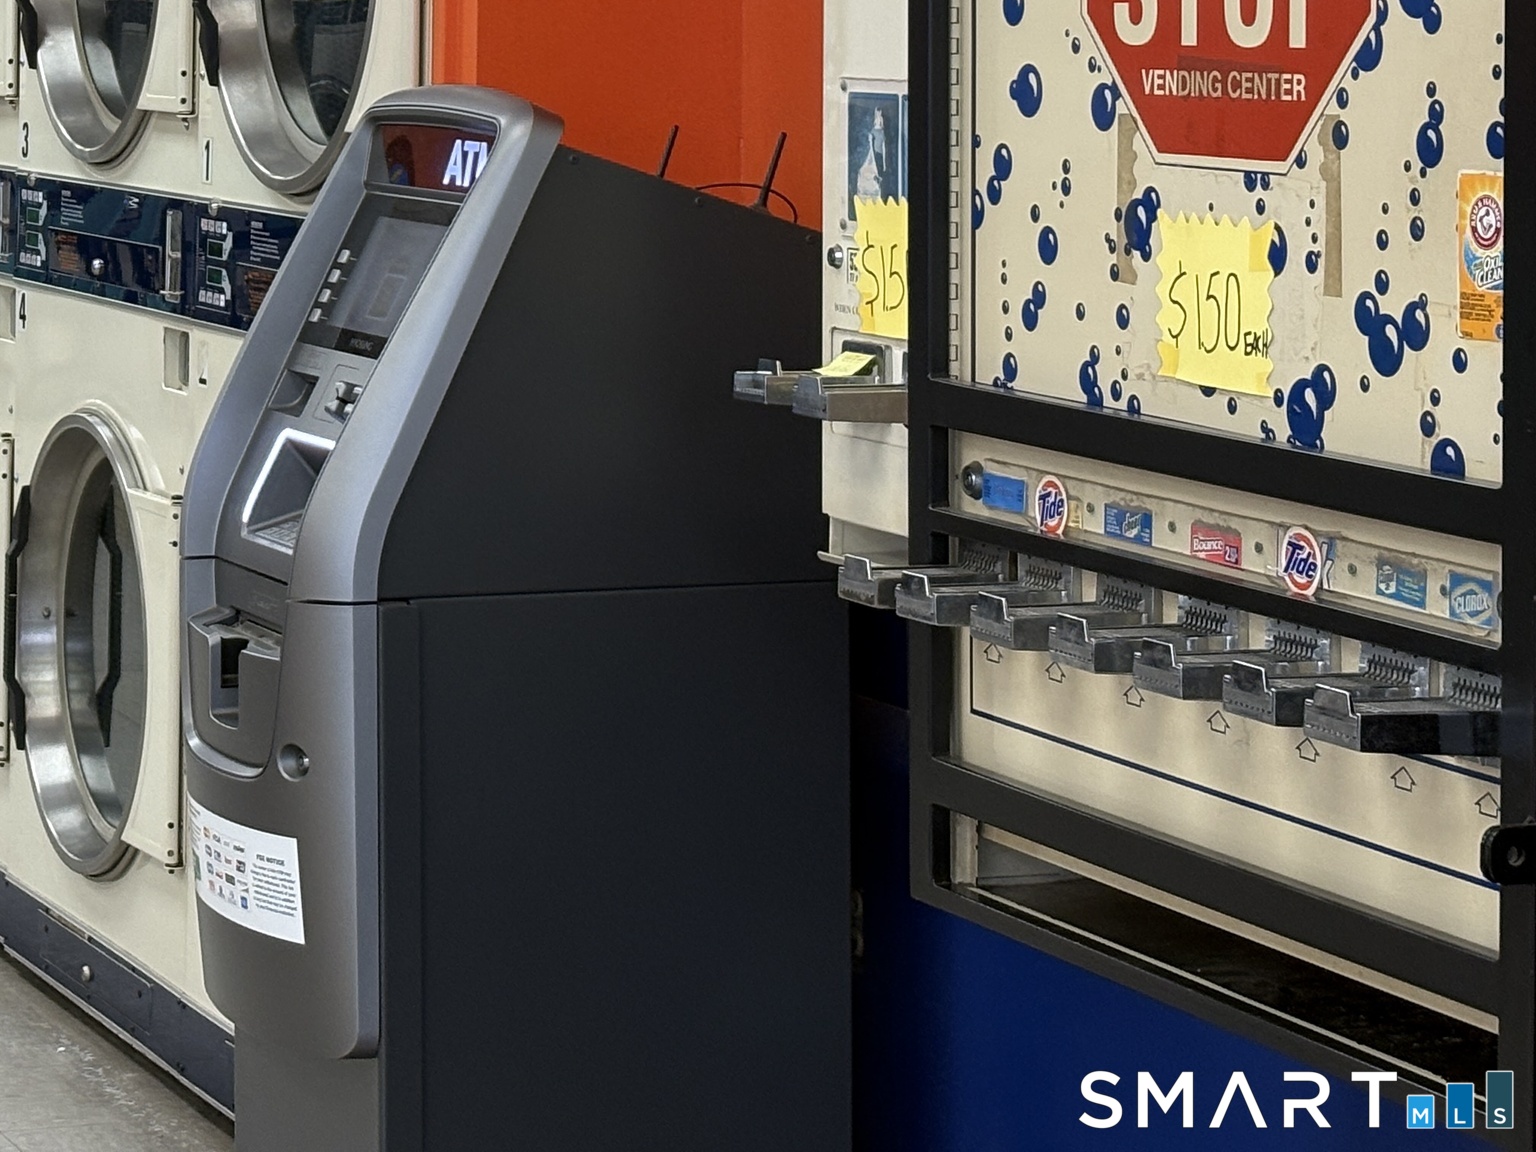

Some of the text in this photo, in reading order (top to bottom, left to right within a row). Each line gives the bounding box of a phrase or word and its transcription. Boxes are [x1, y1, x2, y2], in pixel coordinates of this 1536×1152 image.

[1141, 68, 1306, 102] VENDING CENTER
[21, 122, 30, 158] 3
[203, 138, 212, 182] 1
[18, 292, 27, 330] 4
[1038, 491, 1064, 527] Tide
[1193, 538, 1223, 551] Bounce
[1283, 540, 1318, 579] Tide
[1456, 593, 1489, 613] CLOROX
